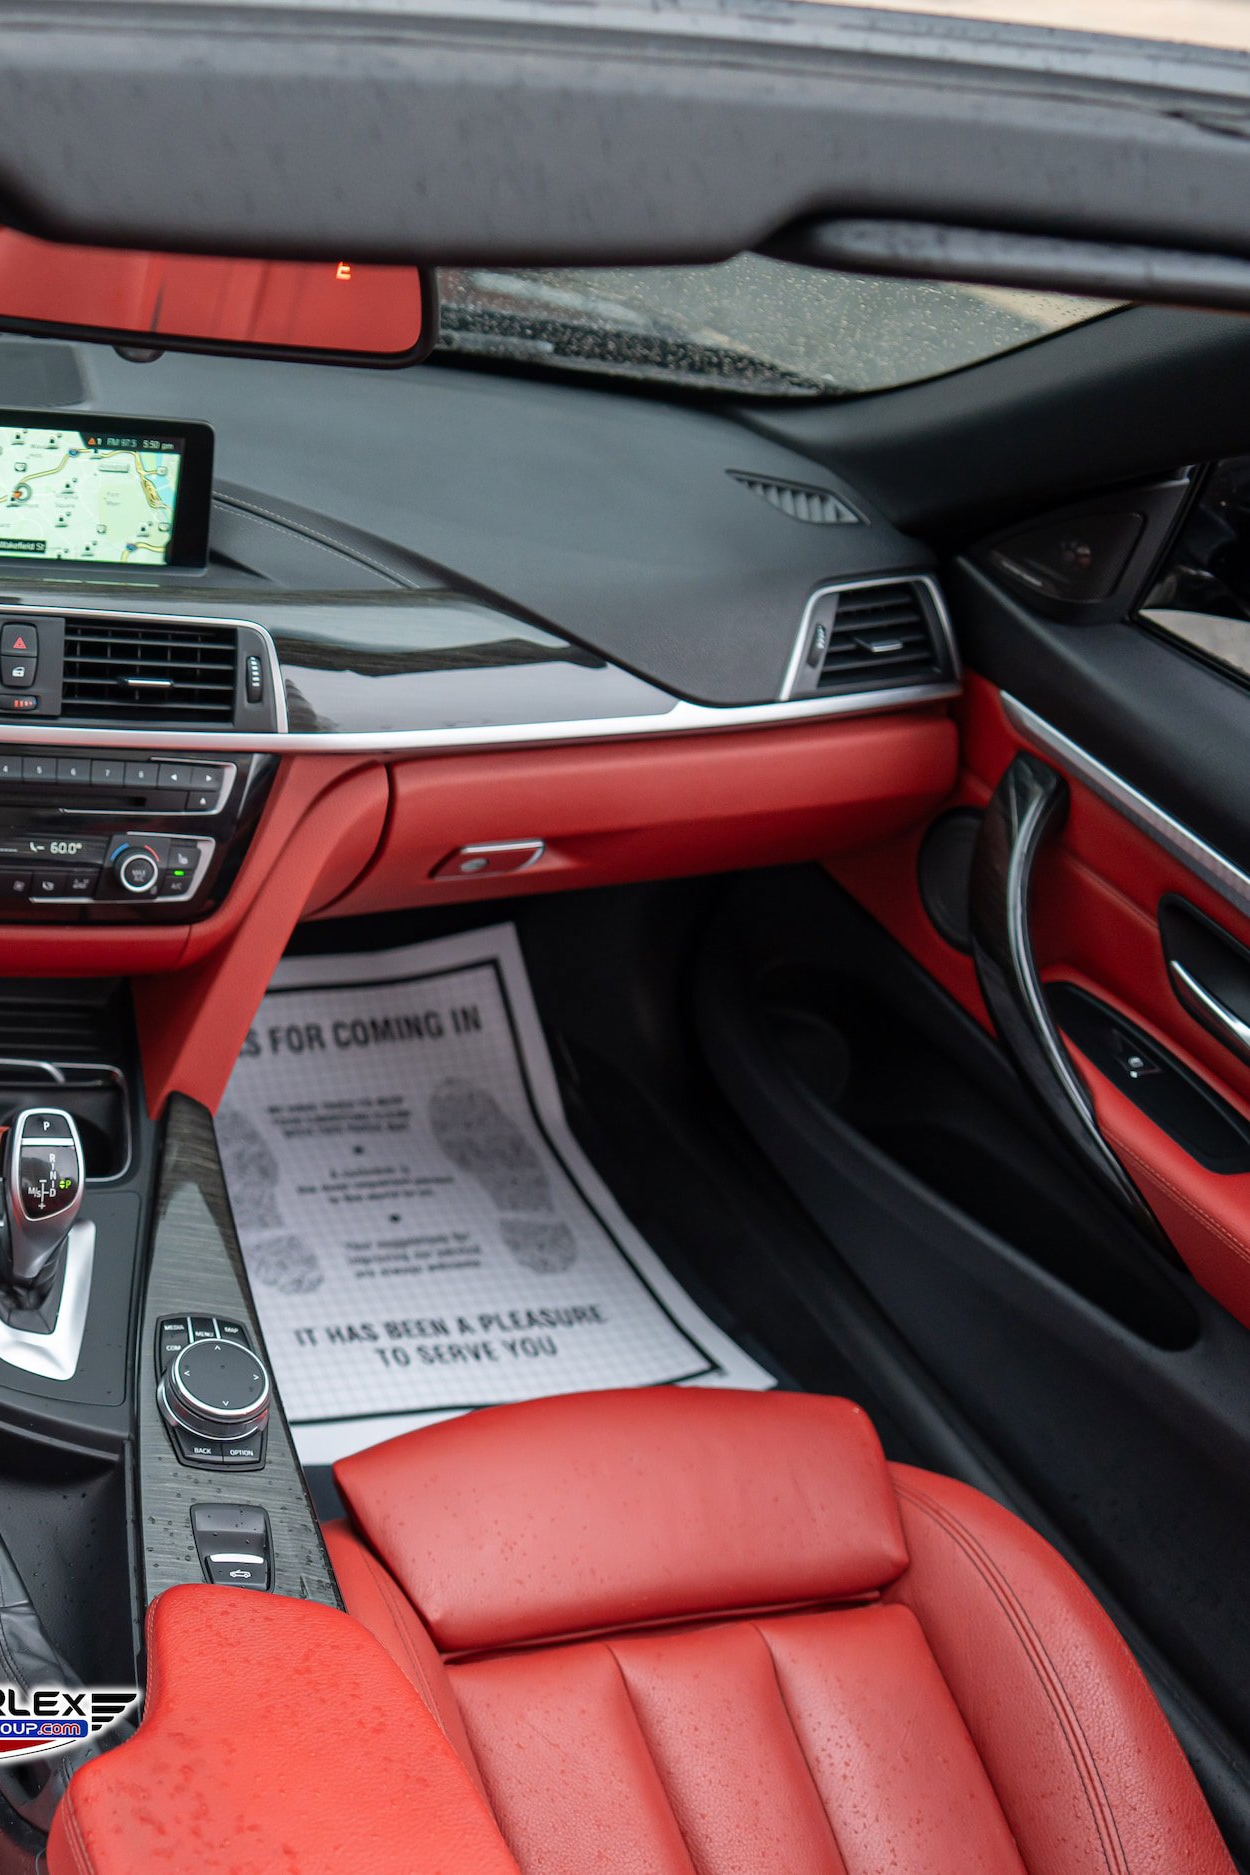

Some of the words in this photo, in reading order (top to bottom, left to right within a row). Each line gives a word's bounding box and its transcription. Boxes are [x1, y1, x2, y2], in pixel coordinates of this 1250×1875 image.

[142, 440, 160, 450] 5:50
[161, 442, 175, 451] pm
[2, 765, 8, 773] 4
[36, 766, 43, 774] 5
[70, 768, 76, 776] 6
[104, 768, 110, 777] 7
[138, 770, 144, 778] 8
[268, 1022, 326, 1055] FOR
[332, 1010, 445, 1049] COMING
[450, 1005, 483, 1036] IN
[43, 1121, 50, 1132] P
[49, 1153, 56, 1163] R
[50, 1170, 57, 1180] N
[65, 1180, 72, 1189] P
[50, 1188, 57, 1198] D
[293, 1326, 319, 1348] IT
[324, 1322, 379, 1346] HAS
[384, 1317, 450, 1341] BEEN
[457, 1315, 475, 1336] A
[478, 1304, 606, 1334] PLEASURE
[194, 1330, 214, 1338] MENU
[166, 1344, 182, 1352] COM
[375, 1346, 411, 1369] TO
[416, 1340, 498, 1366] SERVE
[502, 1336, 558, 1360] YOU
